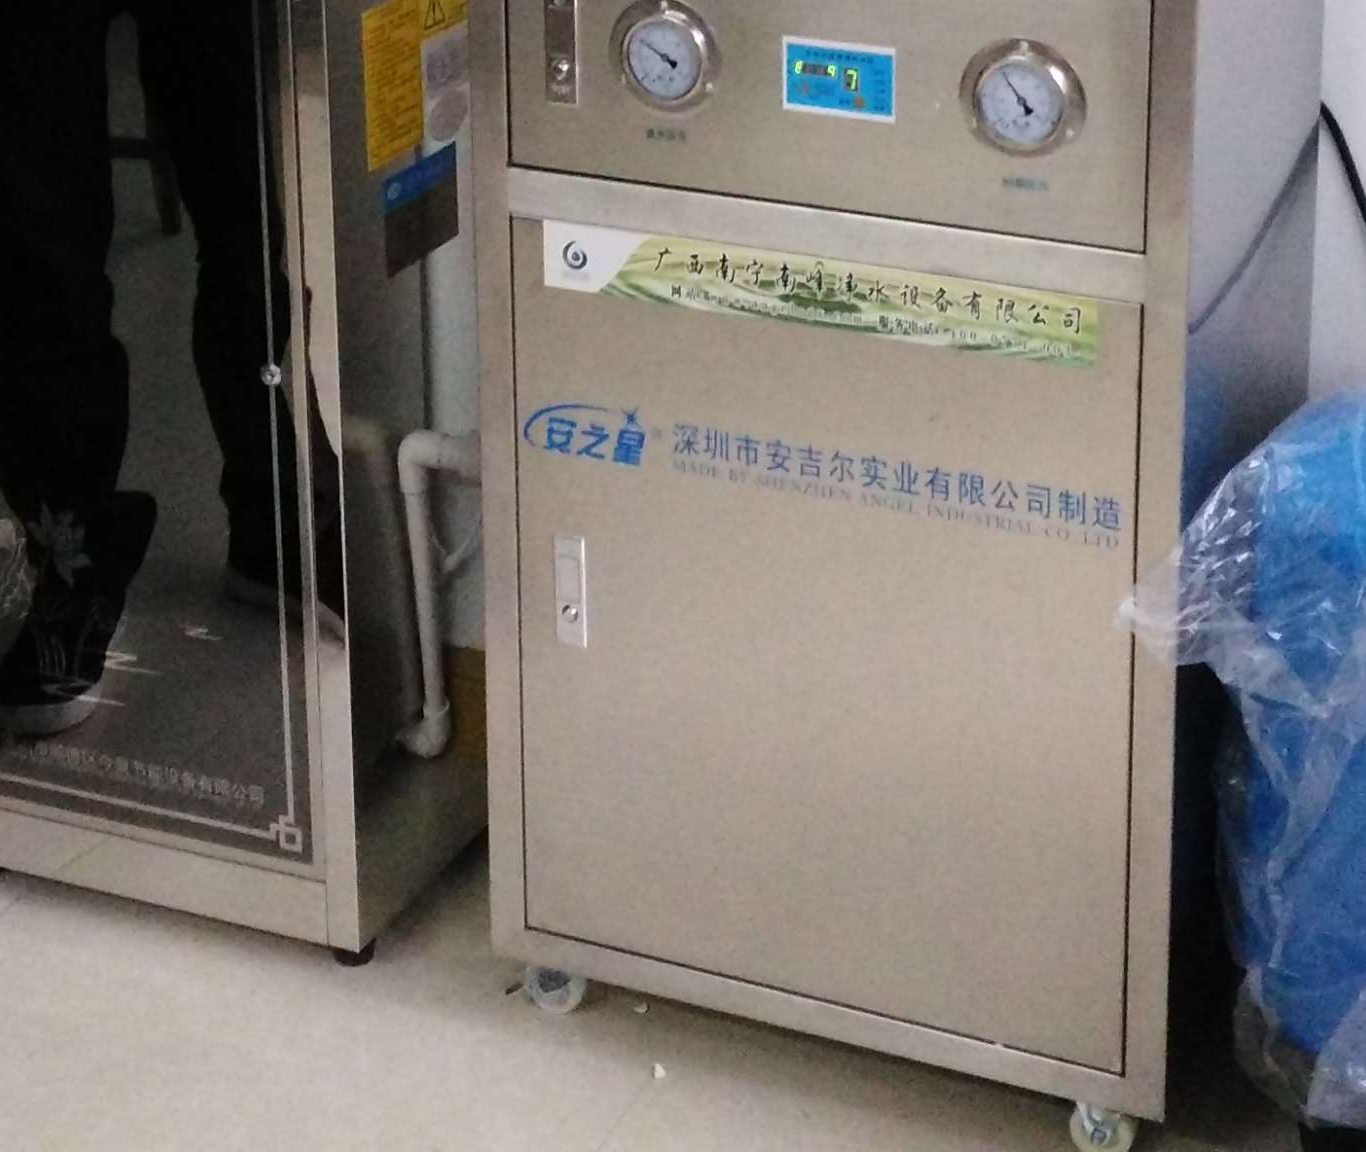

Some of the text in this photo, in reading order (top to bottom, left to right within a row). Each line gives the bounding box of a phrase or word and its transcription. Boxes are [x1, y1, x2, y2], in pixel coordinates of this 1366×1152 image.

[653, 246, 1083, 335] 广西南宁南峰净水设备有限公司
[543, 416, 1122, 531] 安之星 深圳市安吉尔实业有限公司制造
